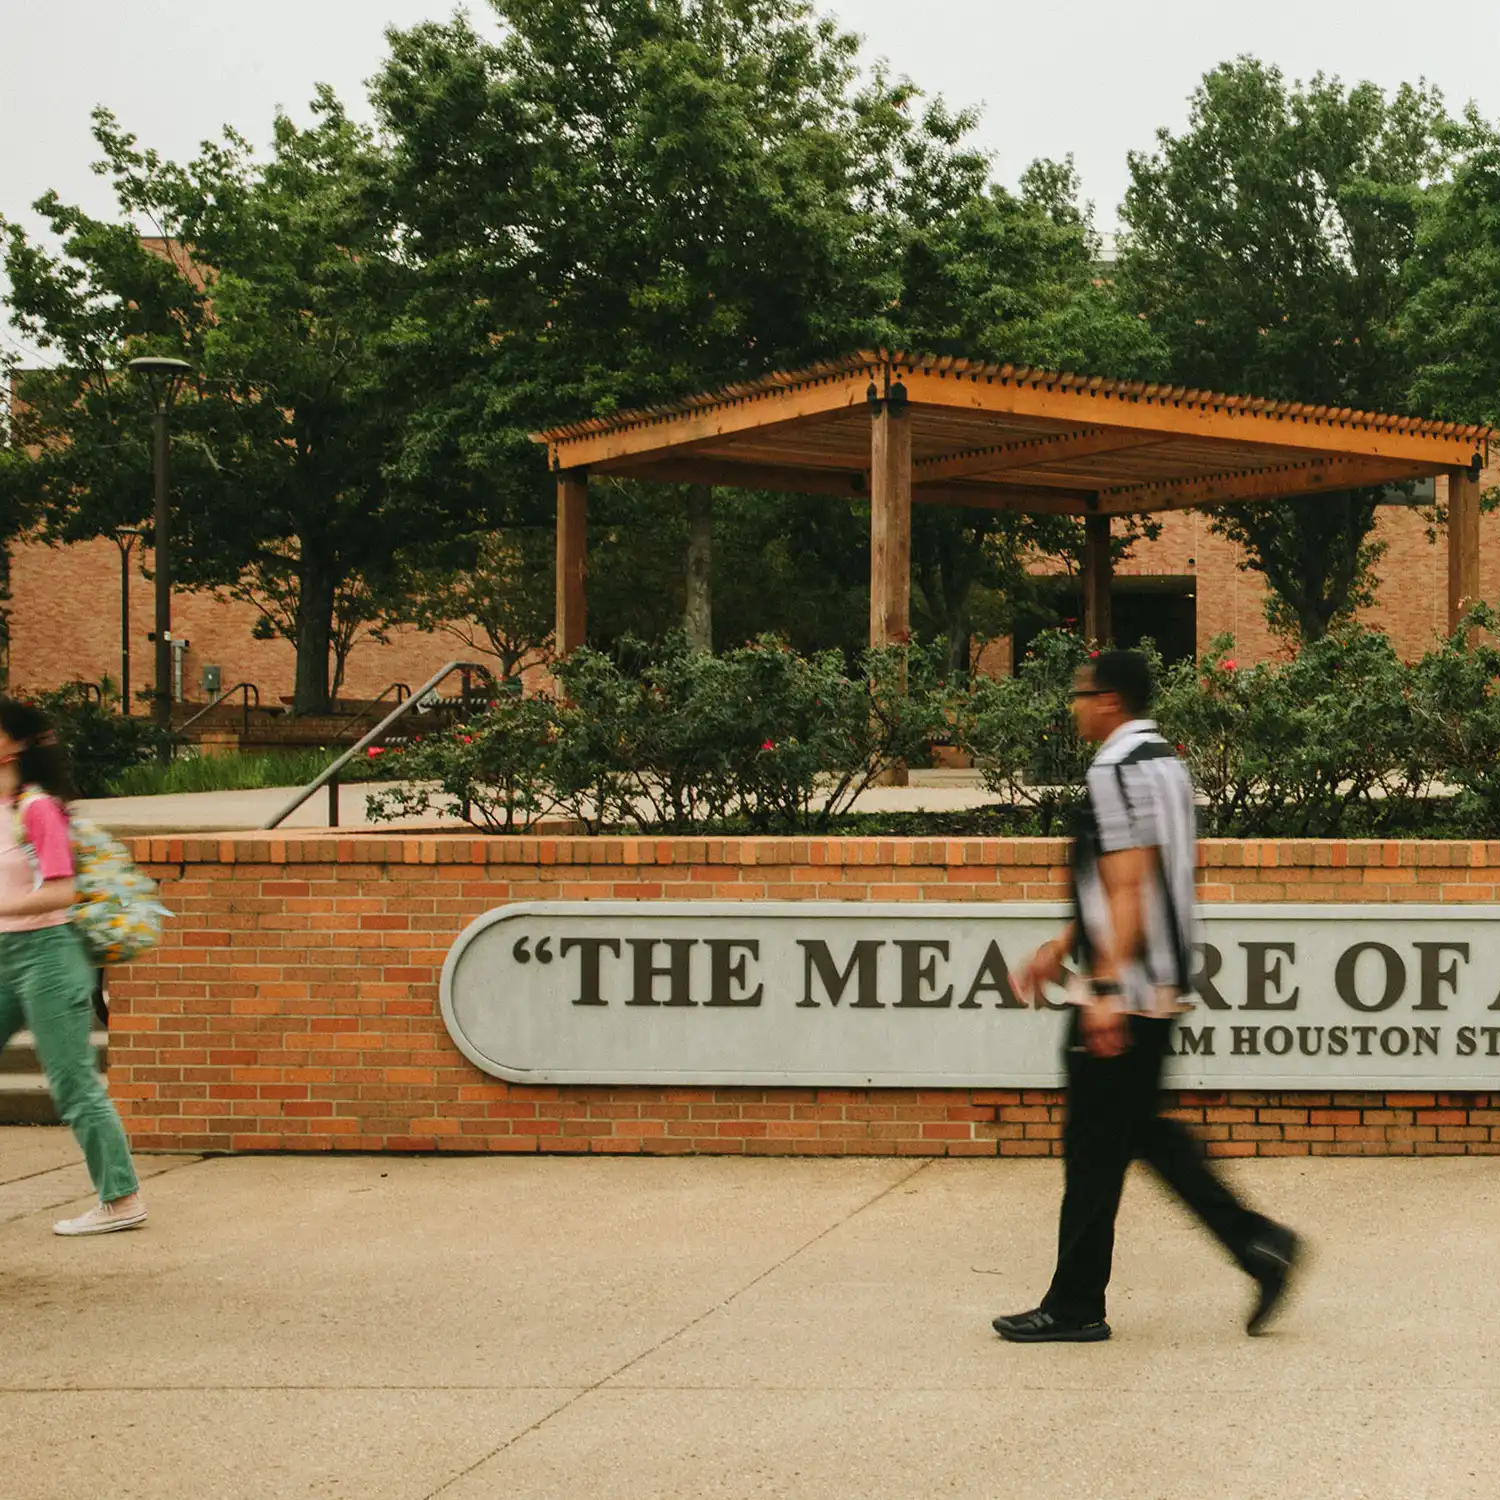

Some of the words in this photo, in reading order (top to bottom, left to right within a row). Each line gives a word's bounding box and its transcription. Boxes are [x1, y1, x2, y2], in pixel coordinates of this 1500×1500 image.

[795, 939, 1300, 1011] MEARE
[1334, 941, 1471, 1012] OF
[1229, 1025, 1441, 1057] HOUSTON
